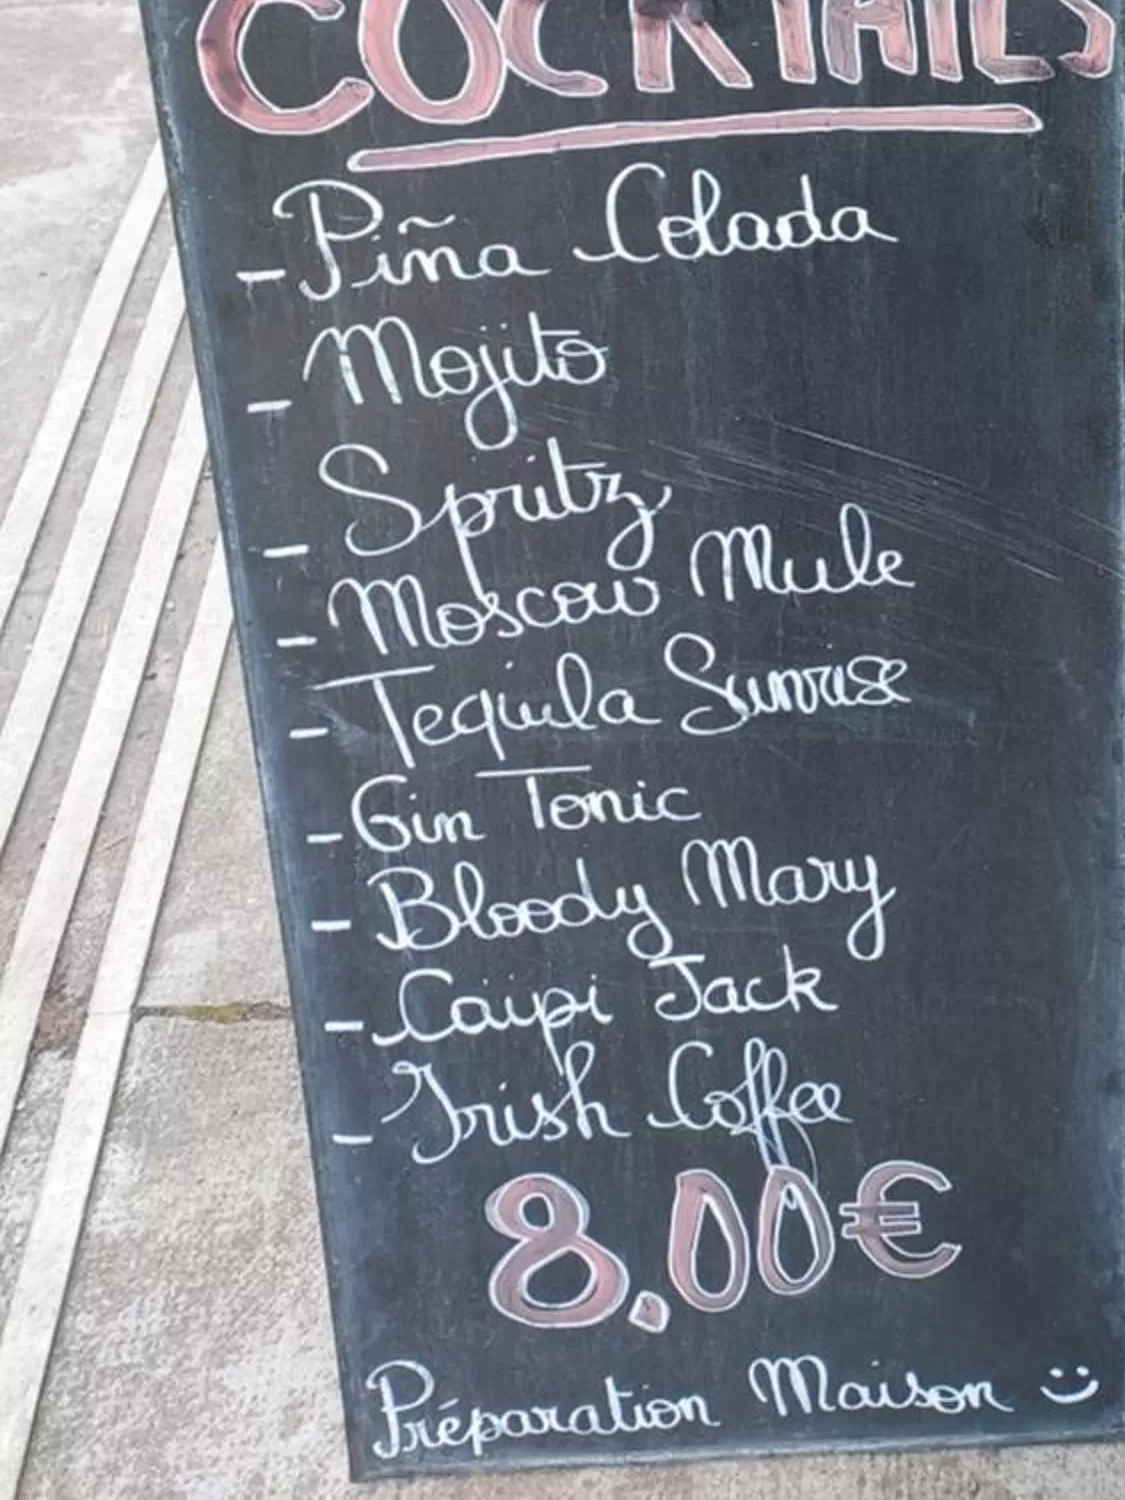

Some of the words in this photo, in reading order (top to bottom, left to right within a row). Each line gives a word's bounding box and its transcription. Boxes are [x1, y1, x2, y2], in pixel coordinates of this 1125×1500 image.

[273, 180, 551, 302] Piña
[575, 161, 900, 264] Colada
[302, 311, 610, 450] Mojito
[318, 435, 673, 599] Spritz
[327, 575, 661, 656] Moscow
[689, 503, 916, 604] Mule
[312, 652, 662, 770] Tequila
[663, 631, 912, 736] Sunrise
[350, 774, 487, 855] Gin
[475, 764, 702, 833] Tonic
[366, 858, 675, 961] Bloody
[681, 836, 898, 962] Mary
[647, 943, 839, 1022] Jack
[380, 1040, 632, 1166] Irish
[646, 1037, 854, 1175] Coffee
[484, 1158, 963, 1335] 8.00€
[365, 1358, 721, 1463] Préparation
[748, 1353, 1014, 1420] Maison
